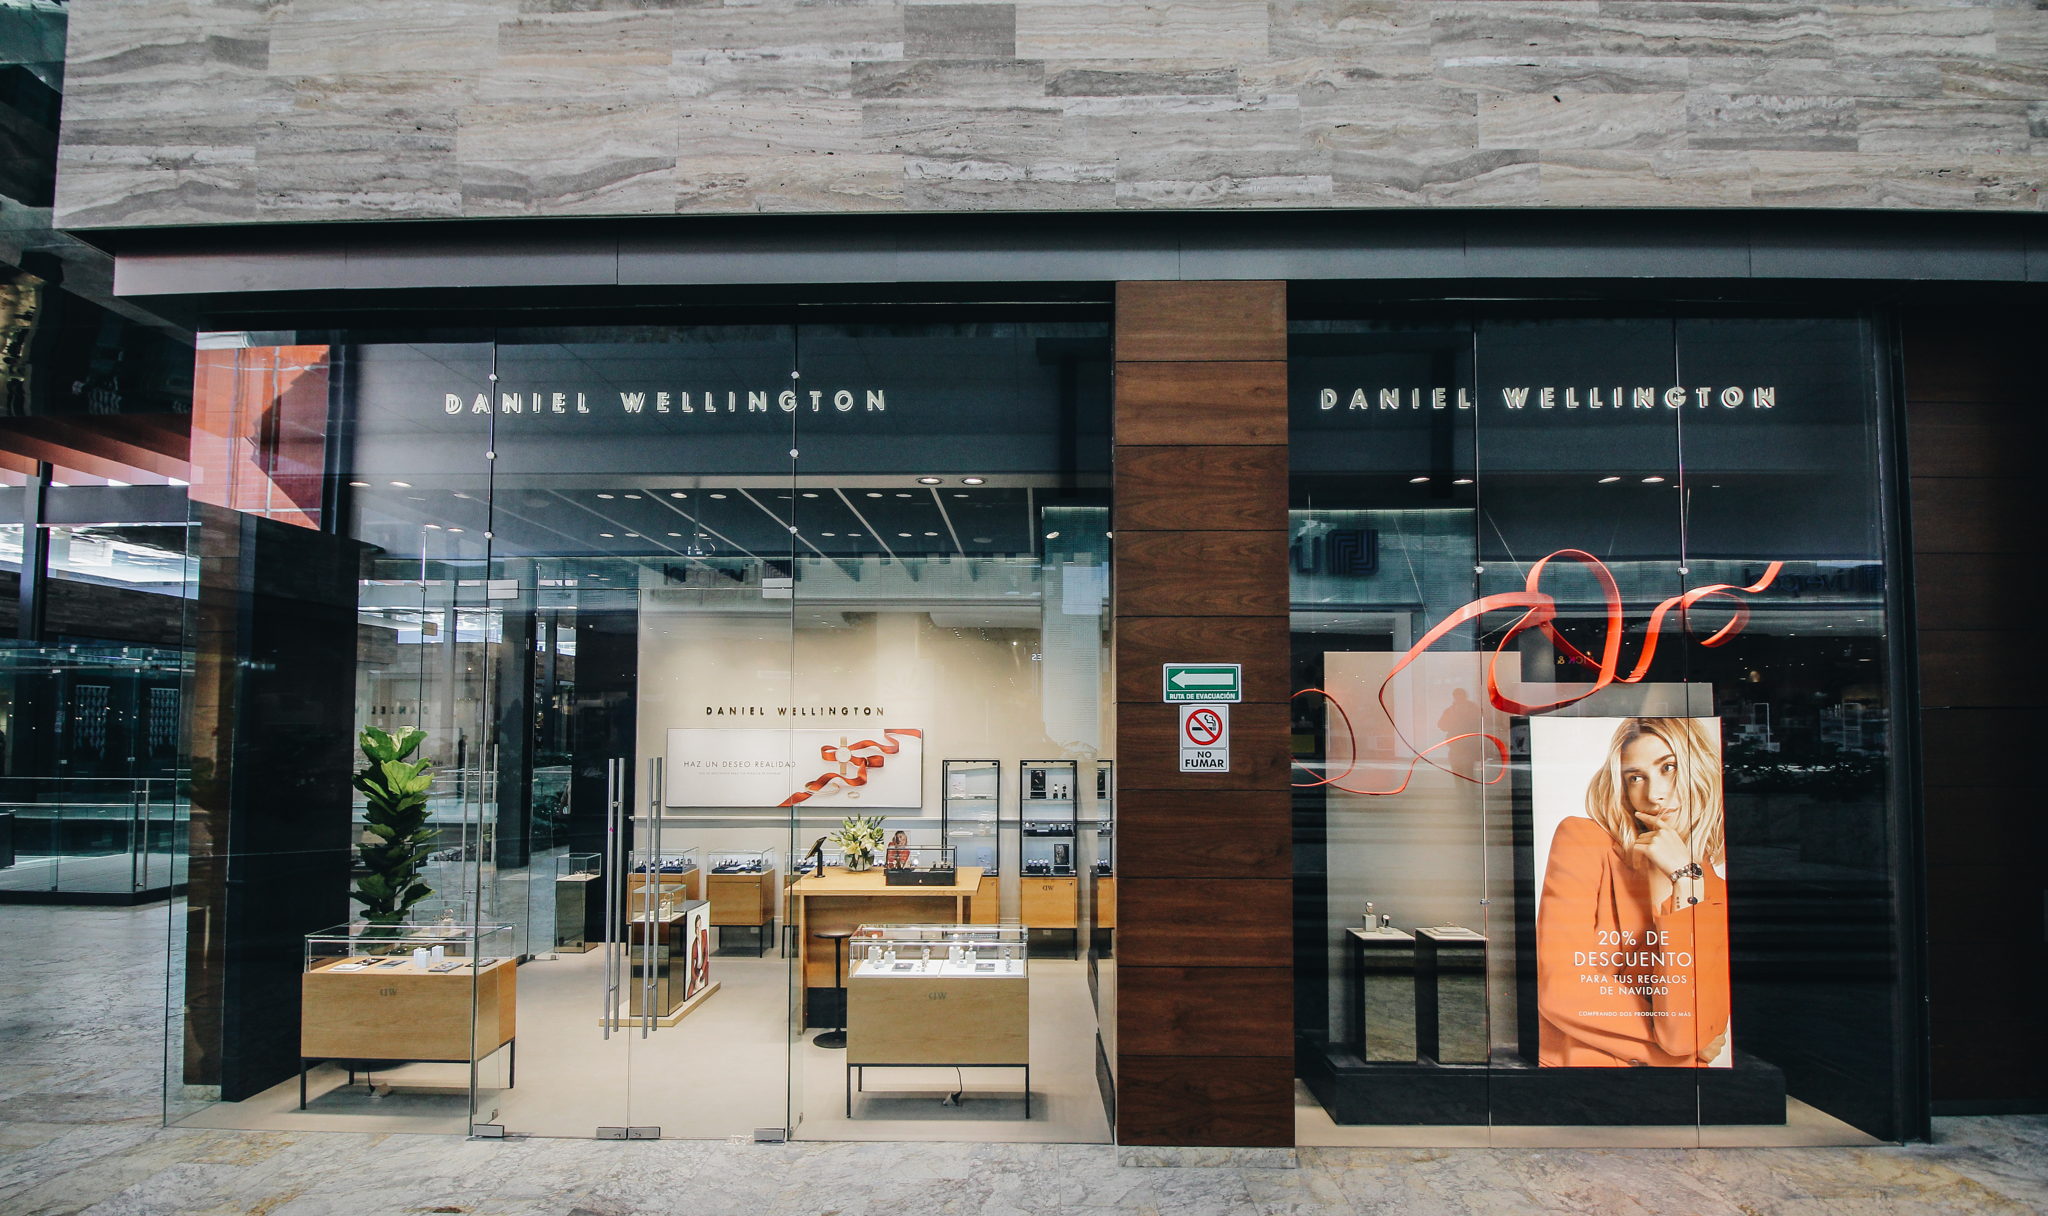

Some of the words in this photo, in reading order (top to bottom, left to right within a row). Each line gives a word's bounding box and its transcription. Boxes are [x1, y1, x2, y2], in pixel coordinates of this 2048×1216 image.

[445, 392, 589, 415] DANIEL
[620, 389, 886, 413] WELLINGTON
[1320, 387, 1472, 410] DANIEL
[1502, 386, 1777, 410] WELLINGTON
[1196, 692, 1236, 700] EVACUACIÓN
[706, 706, 764, 716] DANIEL
[777, 706, 885, 717] WELLINGTON
[1185, 759, 1224, 768] FUMAR
[1598, 930, 1637, 946] 20%
[1646, 930, 1670, 946] DE
[1574, 951, 1692, 967] DESCUENTO
[1580, 974, 1608, 984] PARA
[1613, 974, 1633, 984] TUS
[1637, 974, 1687, 984] REGALOS
[1600, 986, 1614, 996] DE
[1618, 986, 1669, 996] NAVIDAD
